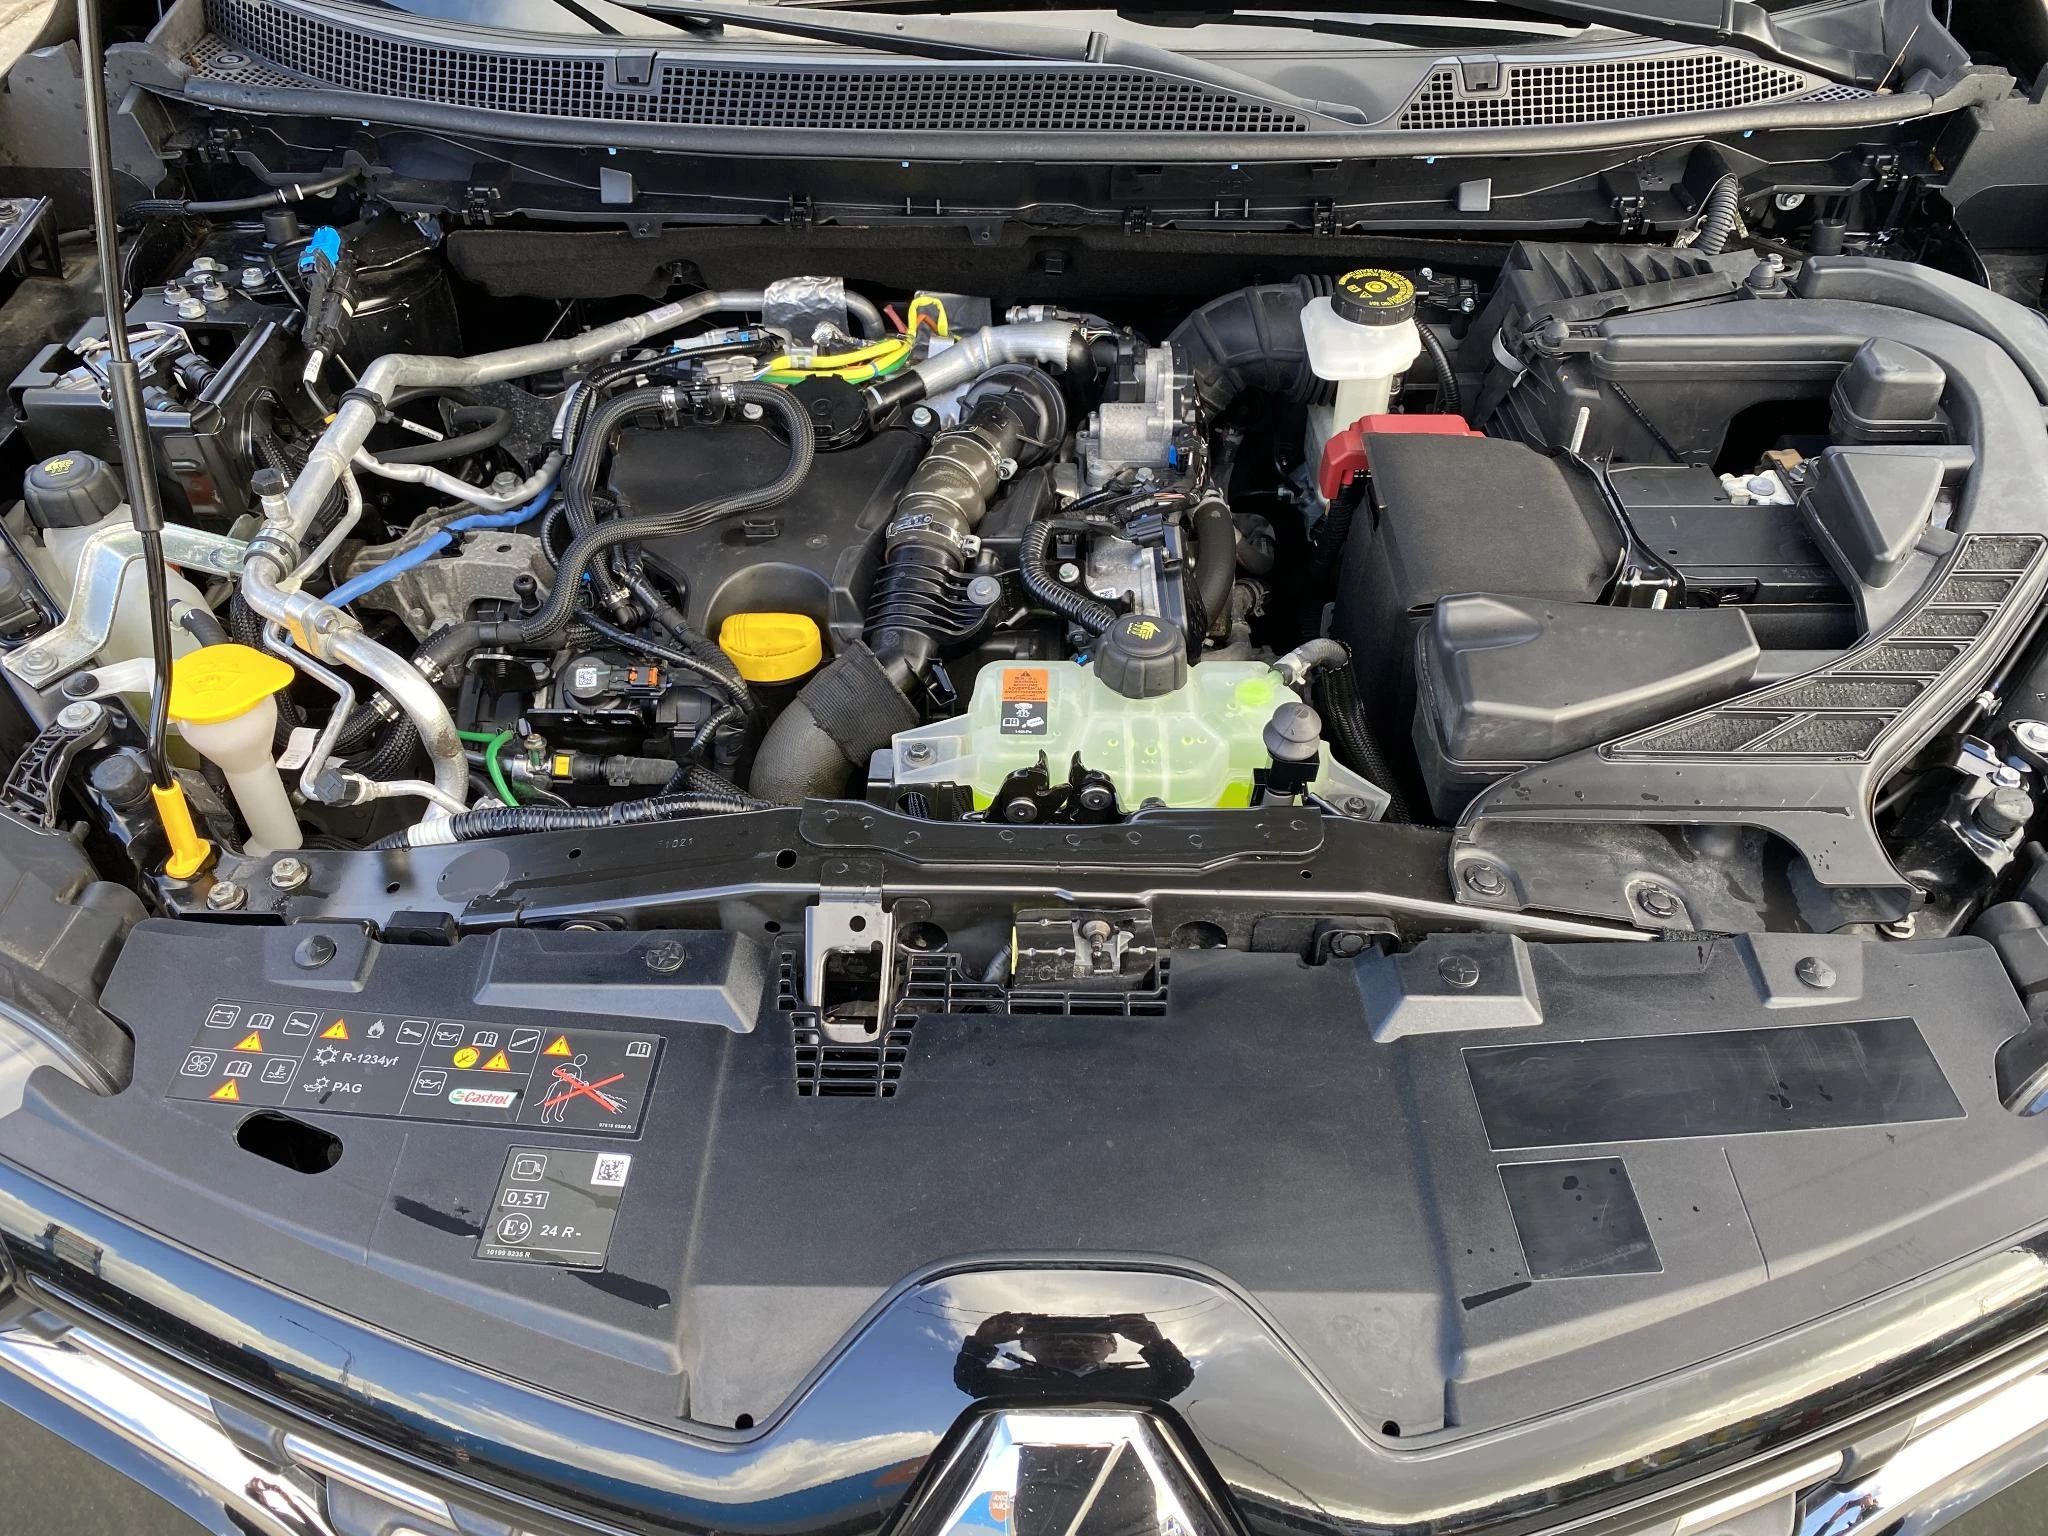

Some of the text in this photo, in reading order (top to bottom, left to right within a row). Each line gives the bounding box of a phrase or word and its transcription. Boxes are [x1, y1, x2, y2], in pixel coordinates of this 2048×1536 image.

[341, 1052, 400, 1068] R-1234yf
[332, 1081, 363, 1093] PAG
[464, 1091, 510, 1105] Castrol
[507, 1191, 543, 1206] 0,51
[501, 1219, 529, 1236] E9
[540, 1225, 558, 1237] 24
